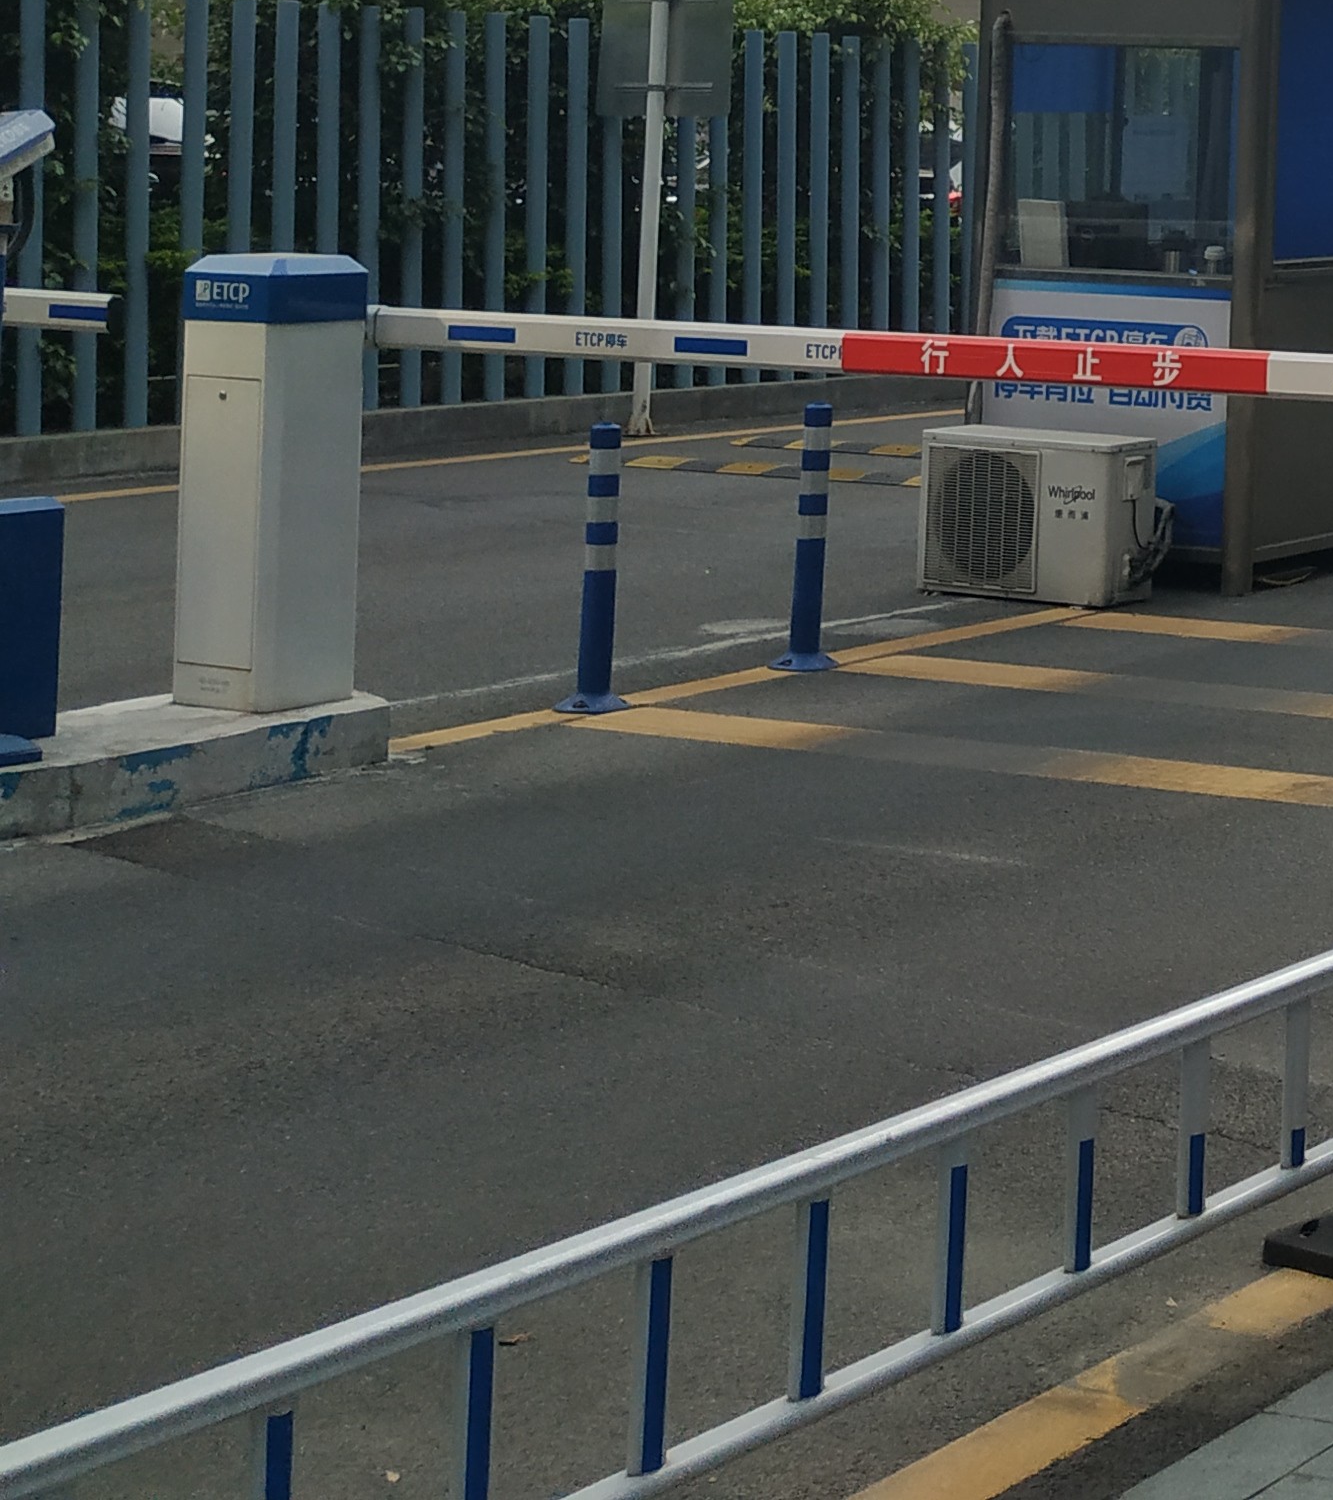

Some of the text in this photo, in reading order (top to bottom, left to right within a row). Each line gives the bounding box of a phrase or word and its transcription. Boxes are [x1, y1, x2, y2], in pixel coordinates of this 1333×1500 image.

[213, 282, 250, 303] ETCP
[575, 330, 628, 349] ETCP停车
[805, 343, 842, 360] ETCP
[920, 338, 1183, 388] 行人止步
[1047, 484, 1096, 505] Whirlpool
